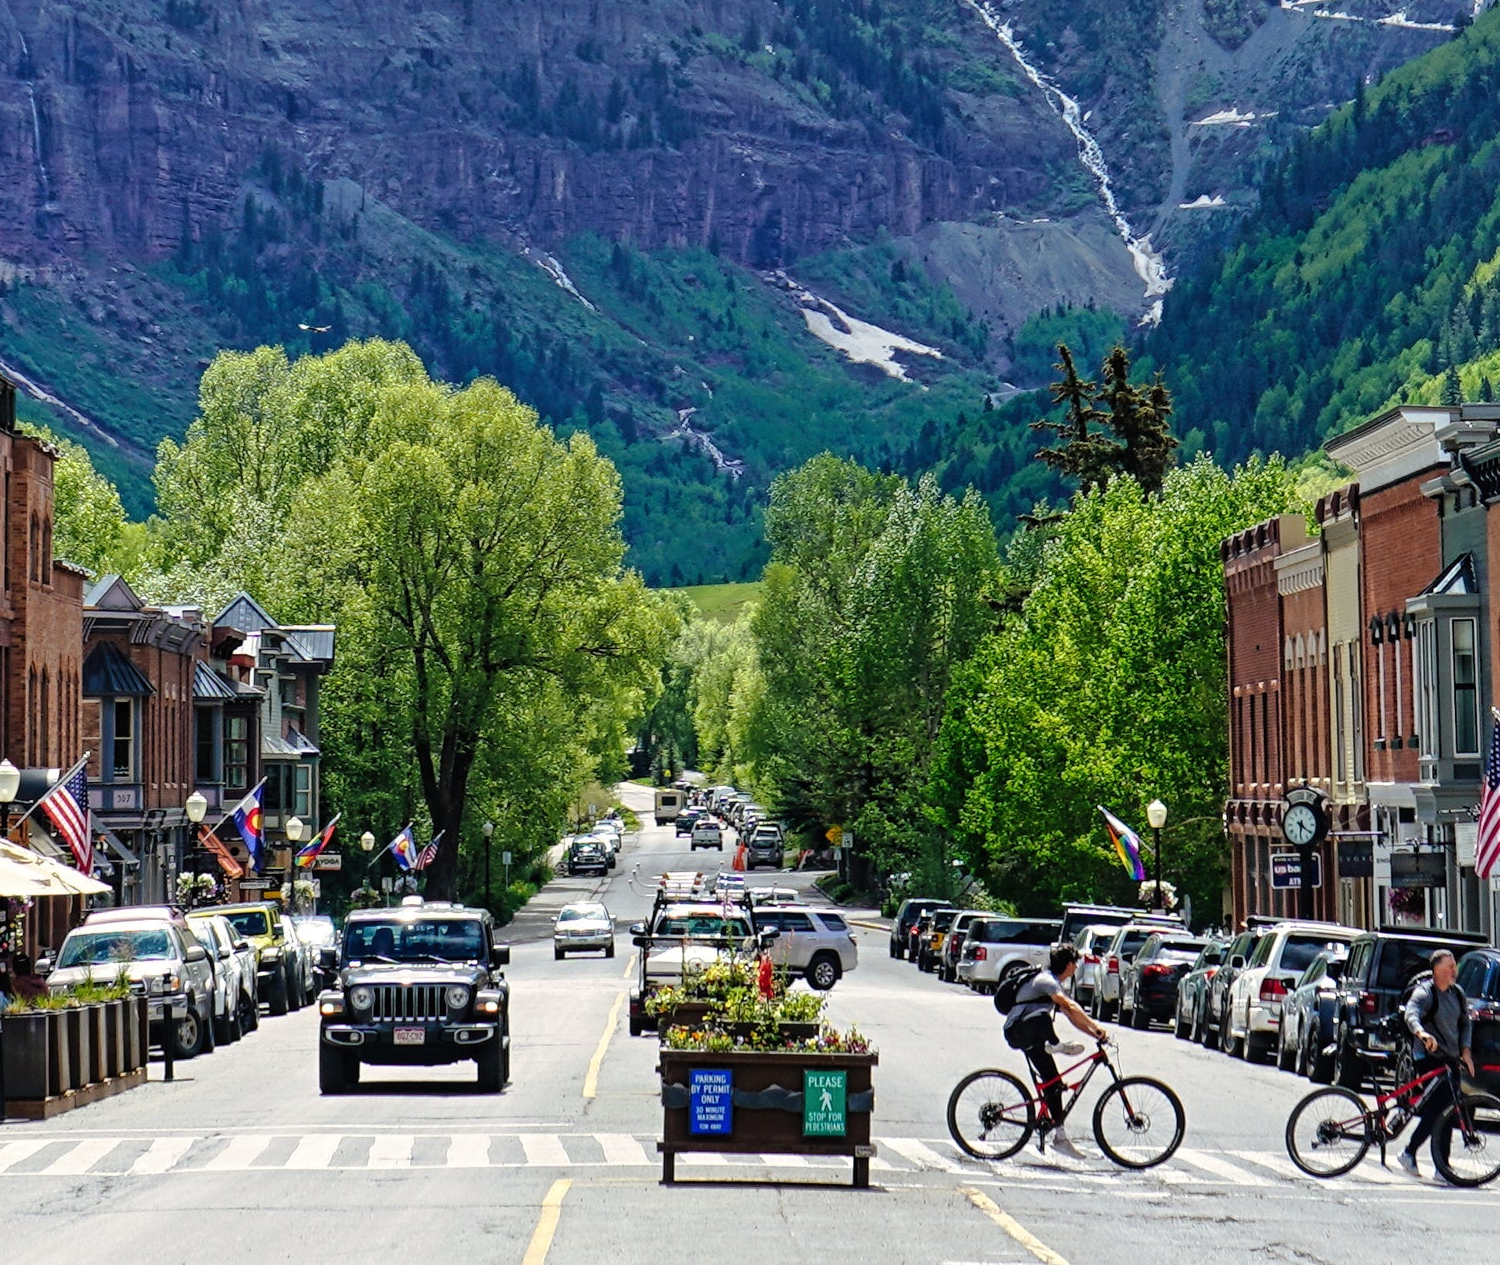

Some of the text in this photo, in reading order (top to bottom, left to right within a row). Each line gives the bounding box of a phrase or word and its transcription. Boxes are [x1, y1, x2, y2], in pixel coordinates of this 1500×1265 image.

[116, 793, 131, 804] 307
[320, 857, 340, 865] YOGA
[1287, 864, 1301, 874] ba
[695, 1074, 726, 1084] PARKING
[808, 1076, 843, 1088] PLEASE
[691, 1084, 730, 1094] BY PERMIT
[701, 1094, 720, 1105] ONLY
[705, 1106, 726, 1115] MINUTE
[808, 1112, 842, 1122] STOP FOR
[805, 1122, 845, 1133] PEDESTRIANS
